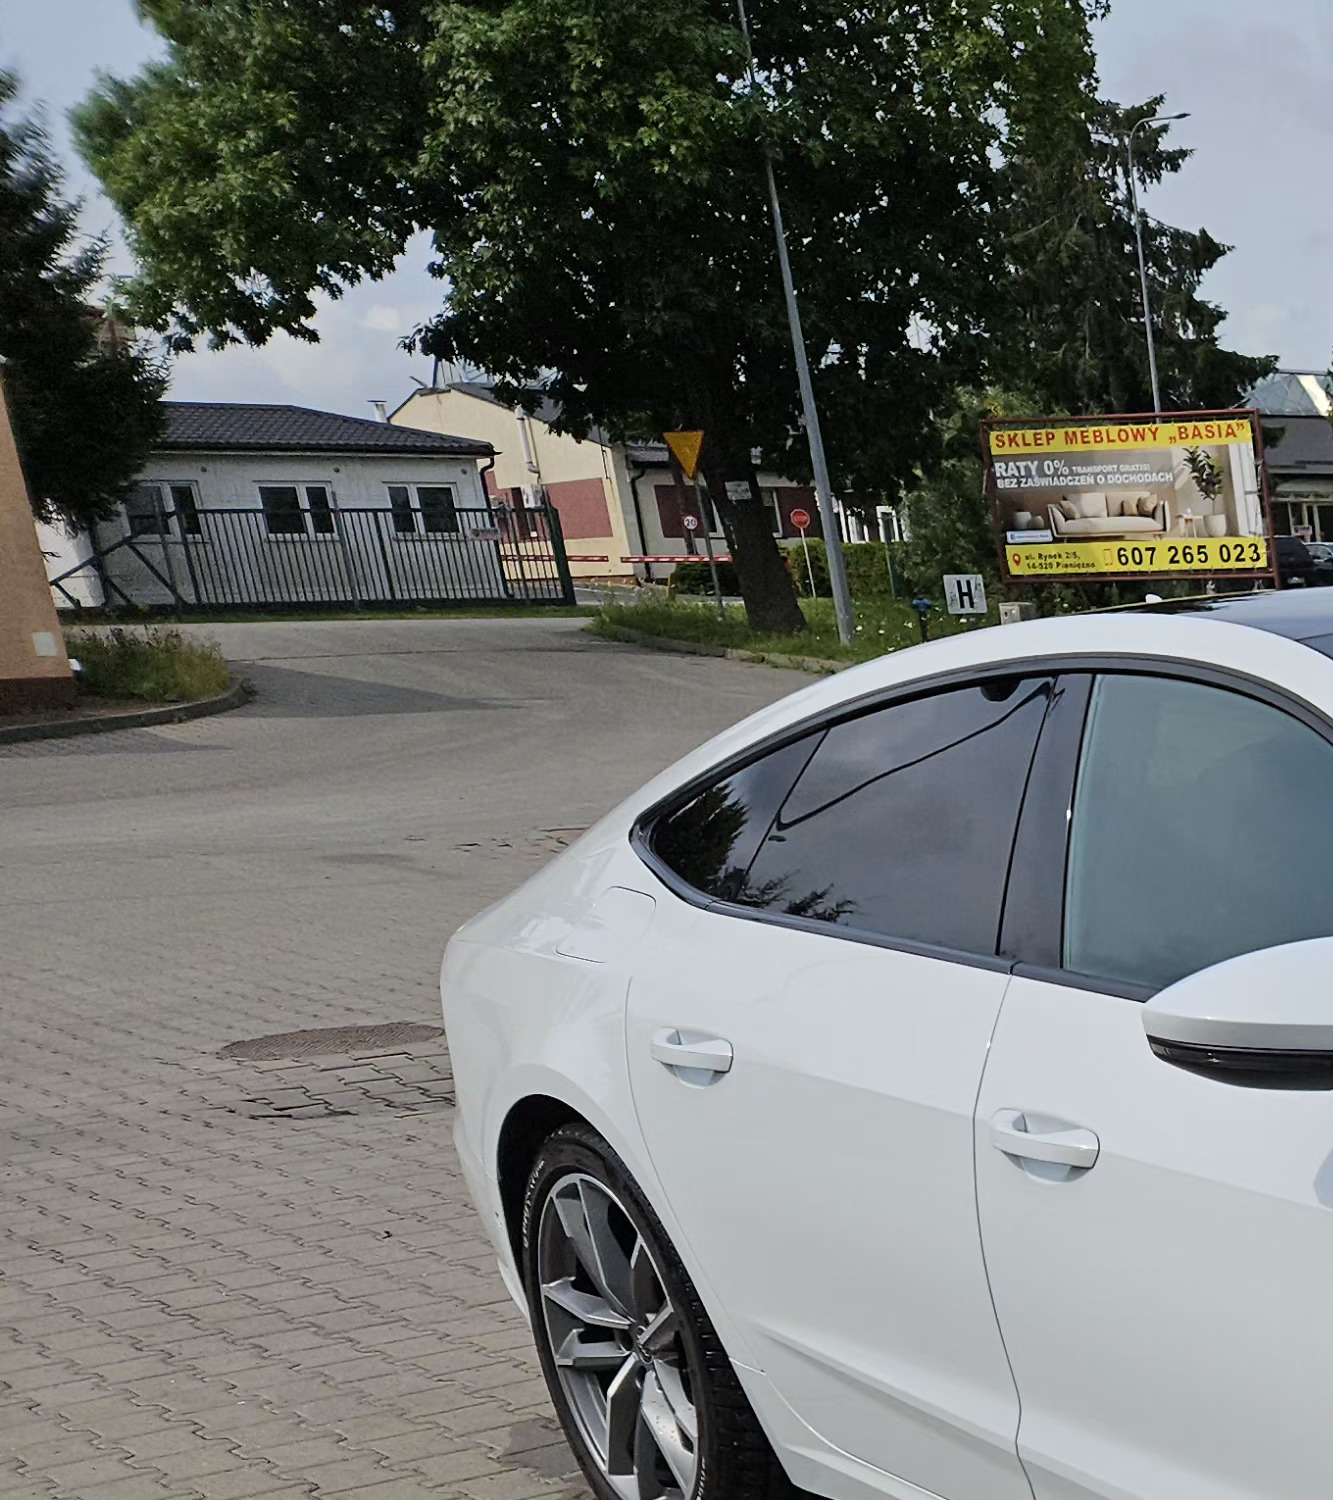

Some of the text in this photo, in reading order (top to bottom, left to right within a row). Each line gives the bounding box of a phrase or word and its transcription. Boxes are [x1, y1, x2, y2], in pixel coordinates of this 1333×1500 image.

[995, 432, 1056, 448] SKLEP
[1064, 427, 1159, 446] MEBLOWY
[994, 460, 1039, 477] RATY
[1044, 459, 1069, 475] 0%
[1072, 465, 1118, 474] TRANSPORT
[997, 476, 1018, 489] BEZ
[1097, 474, 1104, 484] O
[1107, 472, 1174, 484] DOCHODACH
[685, 518, 696, 526] 20
[1117, 543, 1261, 566] 607 265 023
[956, 579, 975, 609] H
